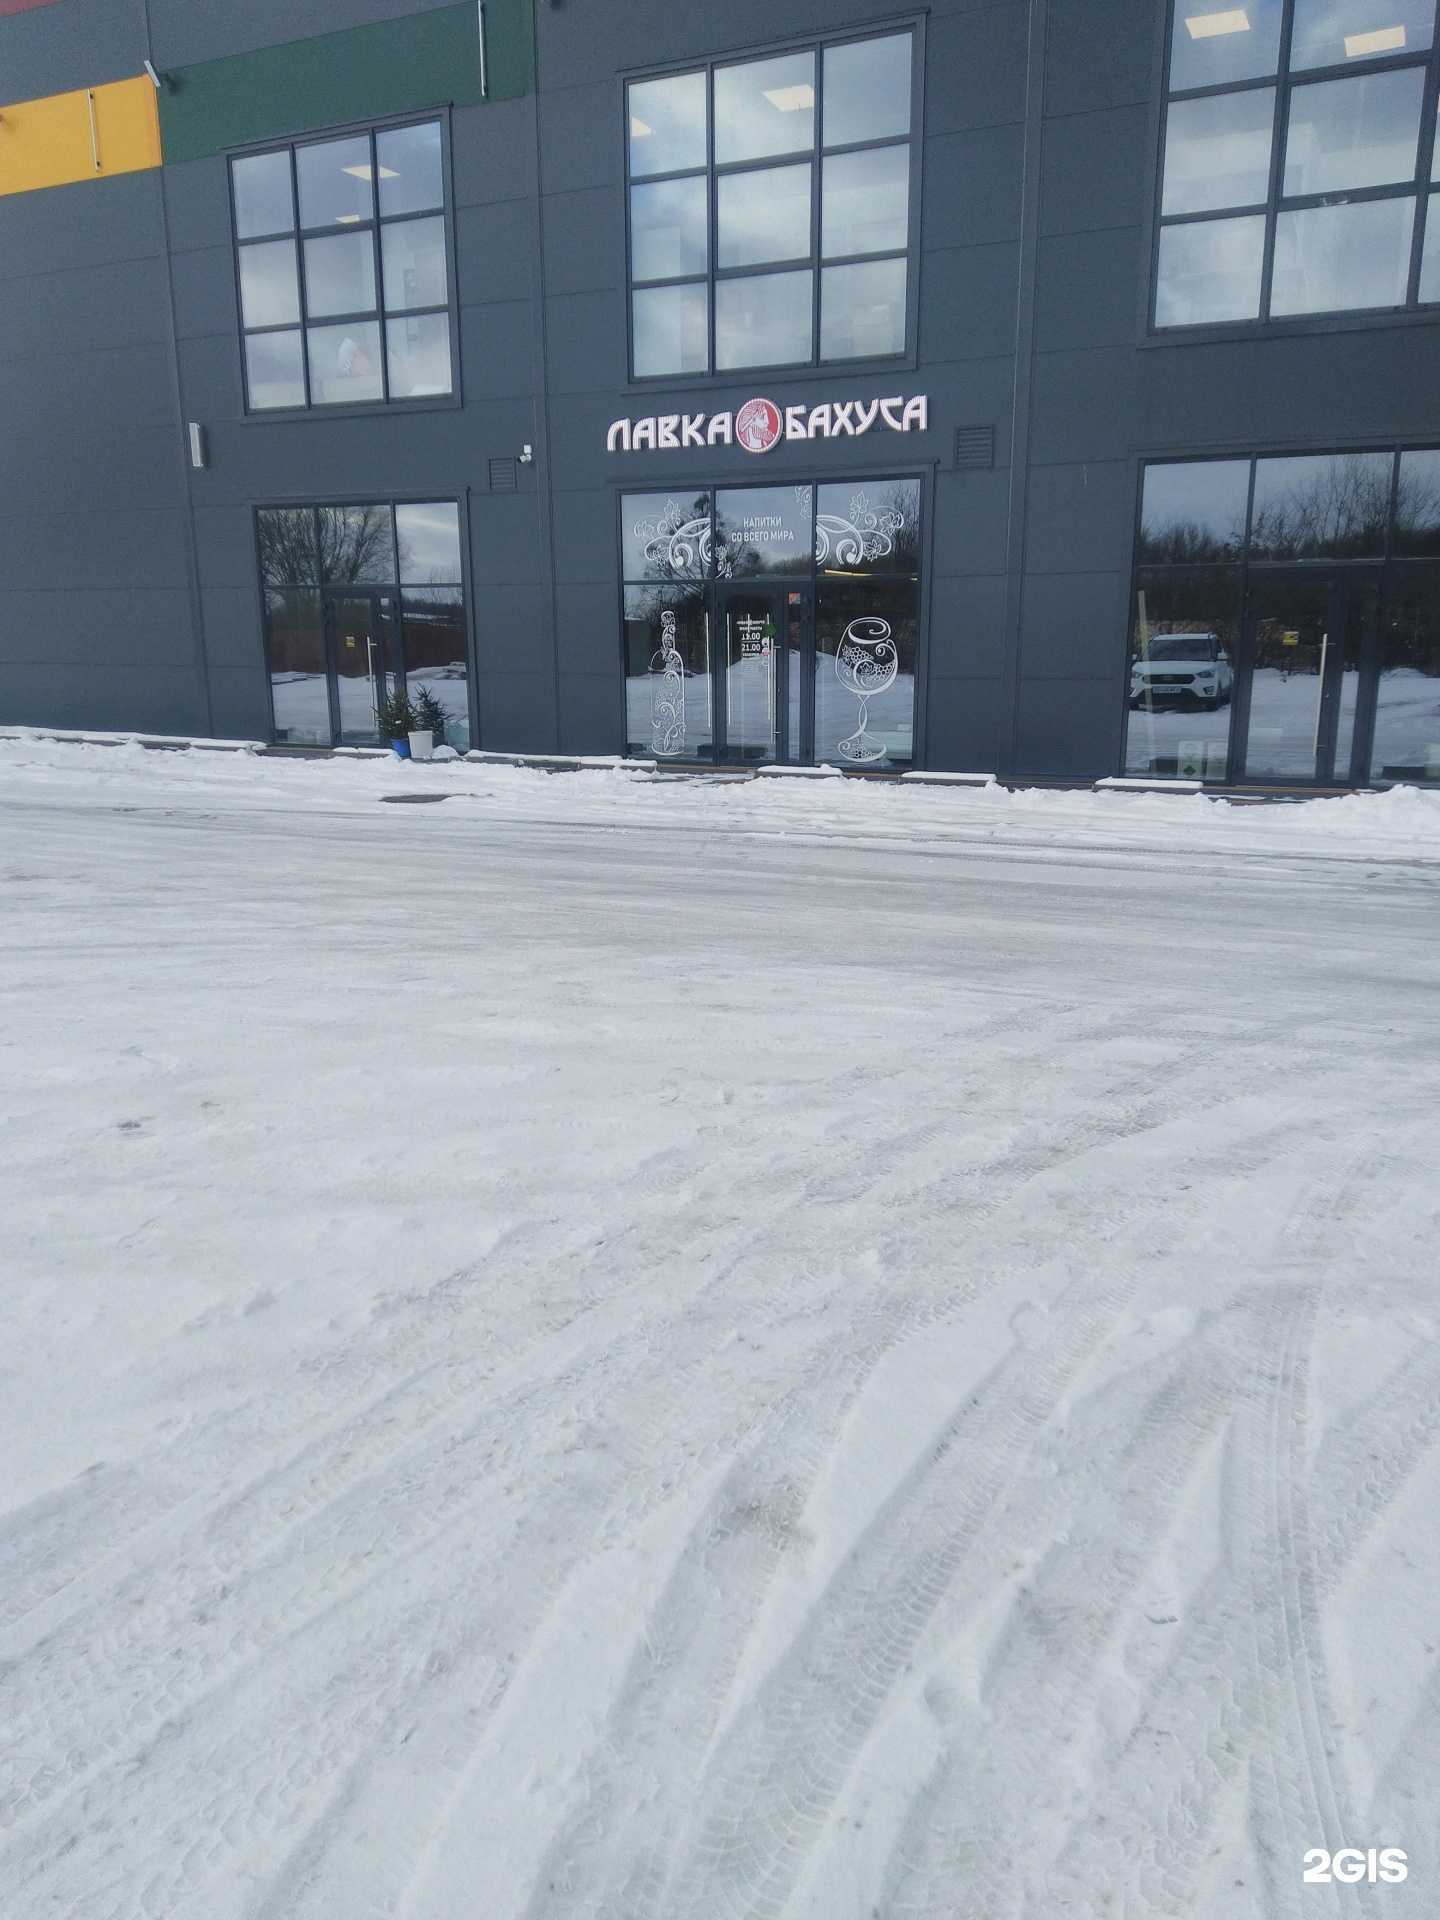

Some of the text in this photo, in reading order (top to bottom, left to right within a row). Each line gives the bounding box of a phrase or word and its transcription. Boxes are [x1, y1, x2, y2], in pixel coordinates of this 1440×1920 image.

[607, 395, 928, 451] ЛАВКА БАХУСА
[743, 516, 782, 528] НАПИТКИ
[731, 529, 794, 542] СО ВСЕГО МИРА
[741, 643, 761, 652] 21.00
